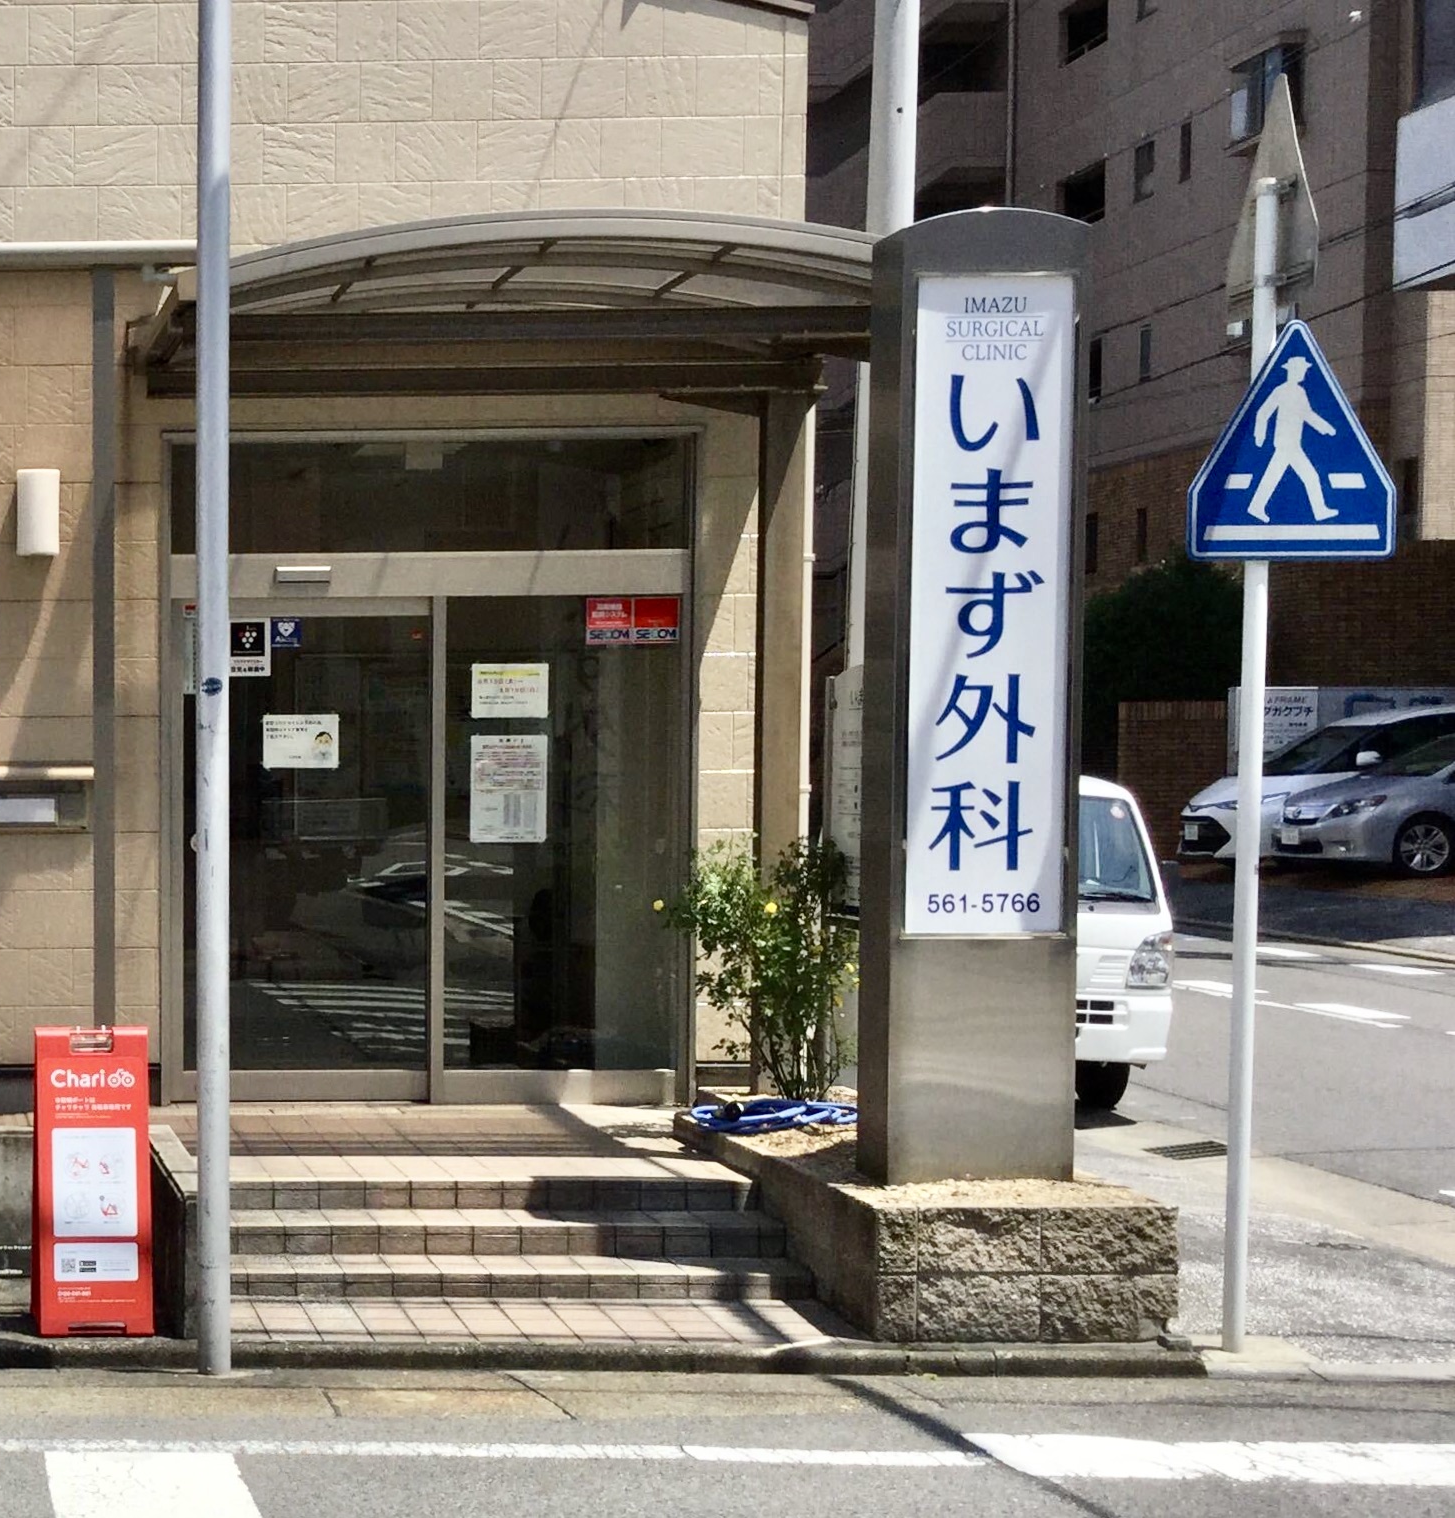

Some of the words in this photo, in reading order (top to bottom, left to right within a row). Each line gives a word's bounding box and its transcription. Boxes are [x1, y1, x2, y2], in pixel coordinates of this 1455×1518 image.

[965, 296, 1027, 313] IMAZU
[946, 320, 1044, 338] SURGICAL
[962, 344, 1027, 361] CLINIC
[929, 374, 1045, 871] いまず外科
[589, 629, 630, 640] SECOM
[636, 628, 677, 639] SECOM
[927, 892, 1040, 914] 561-5766
